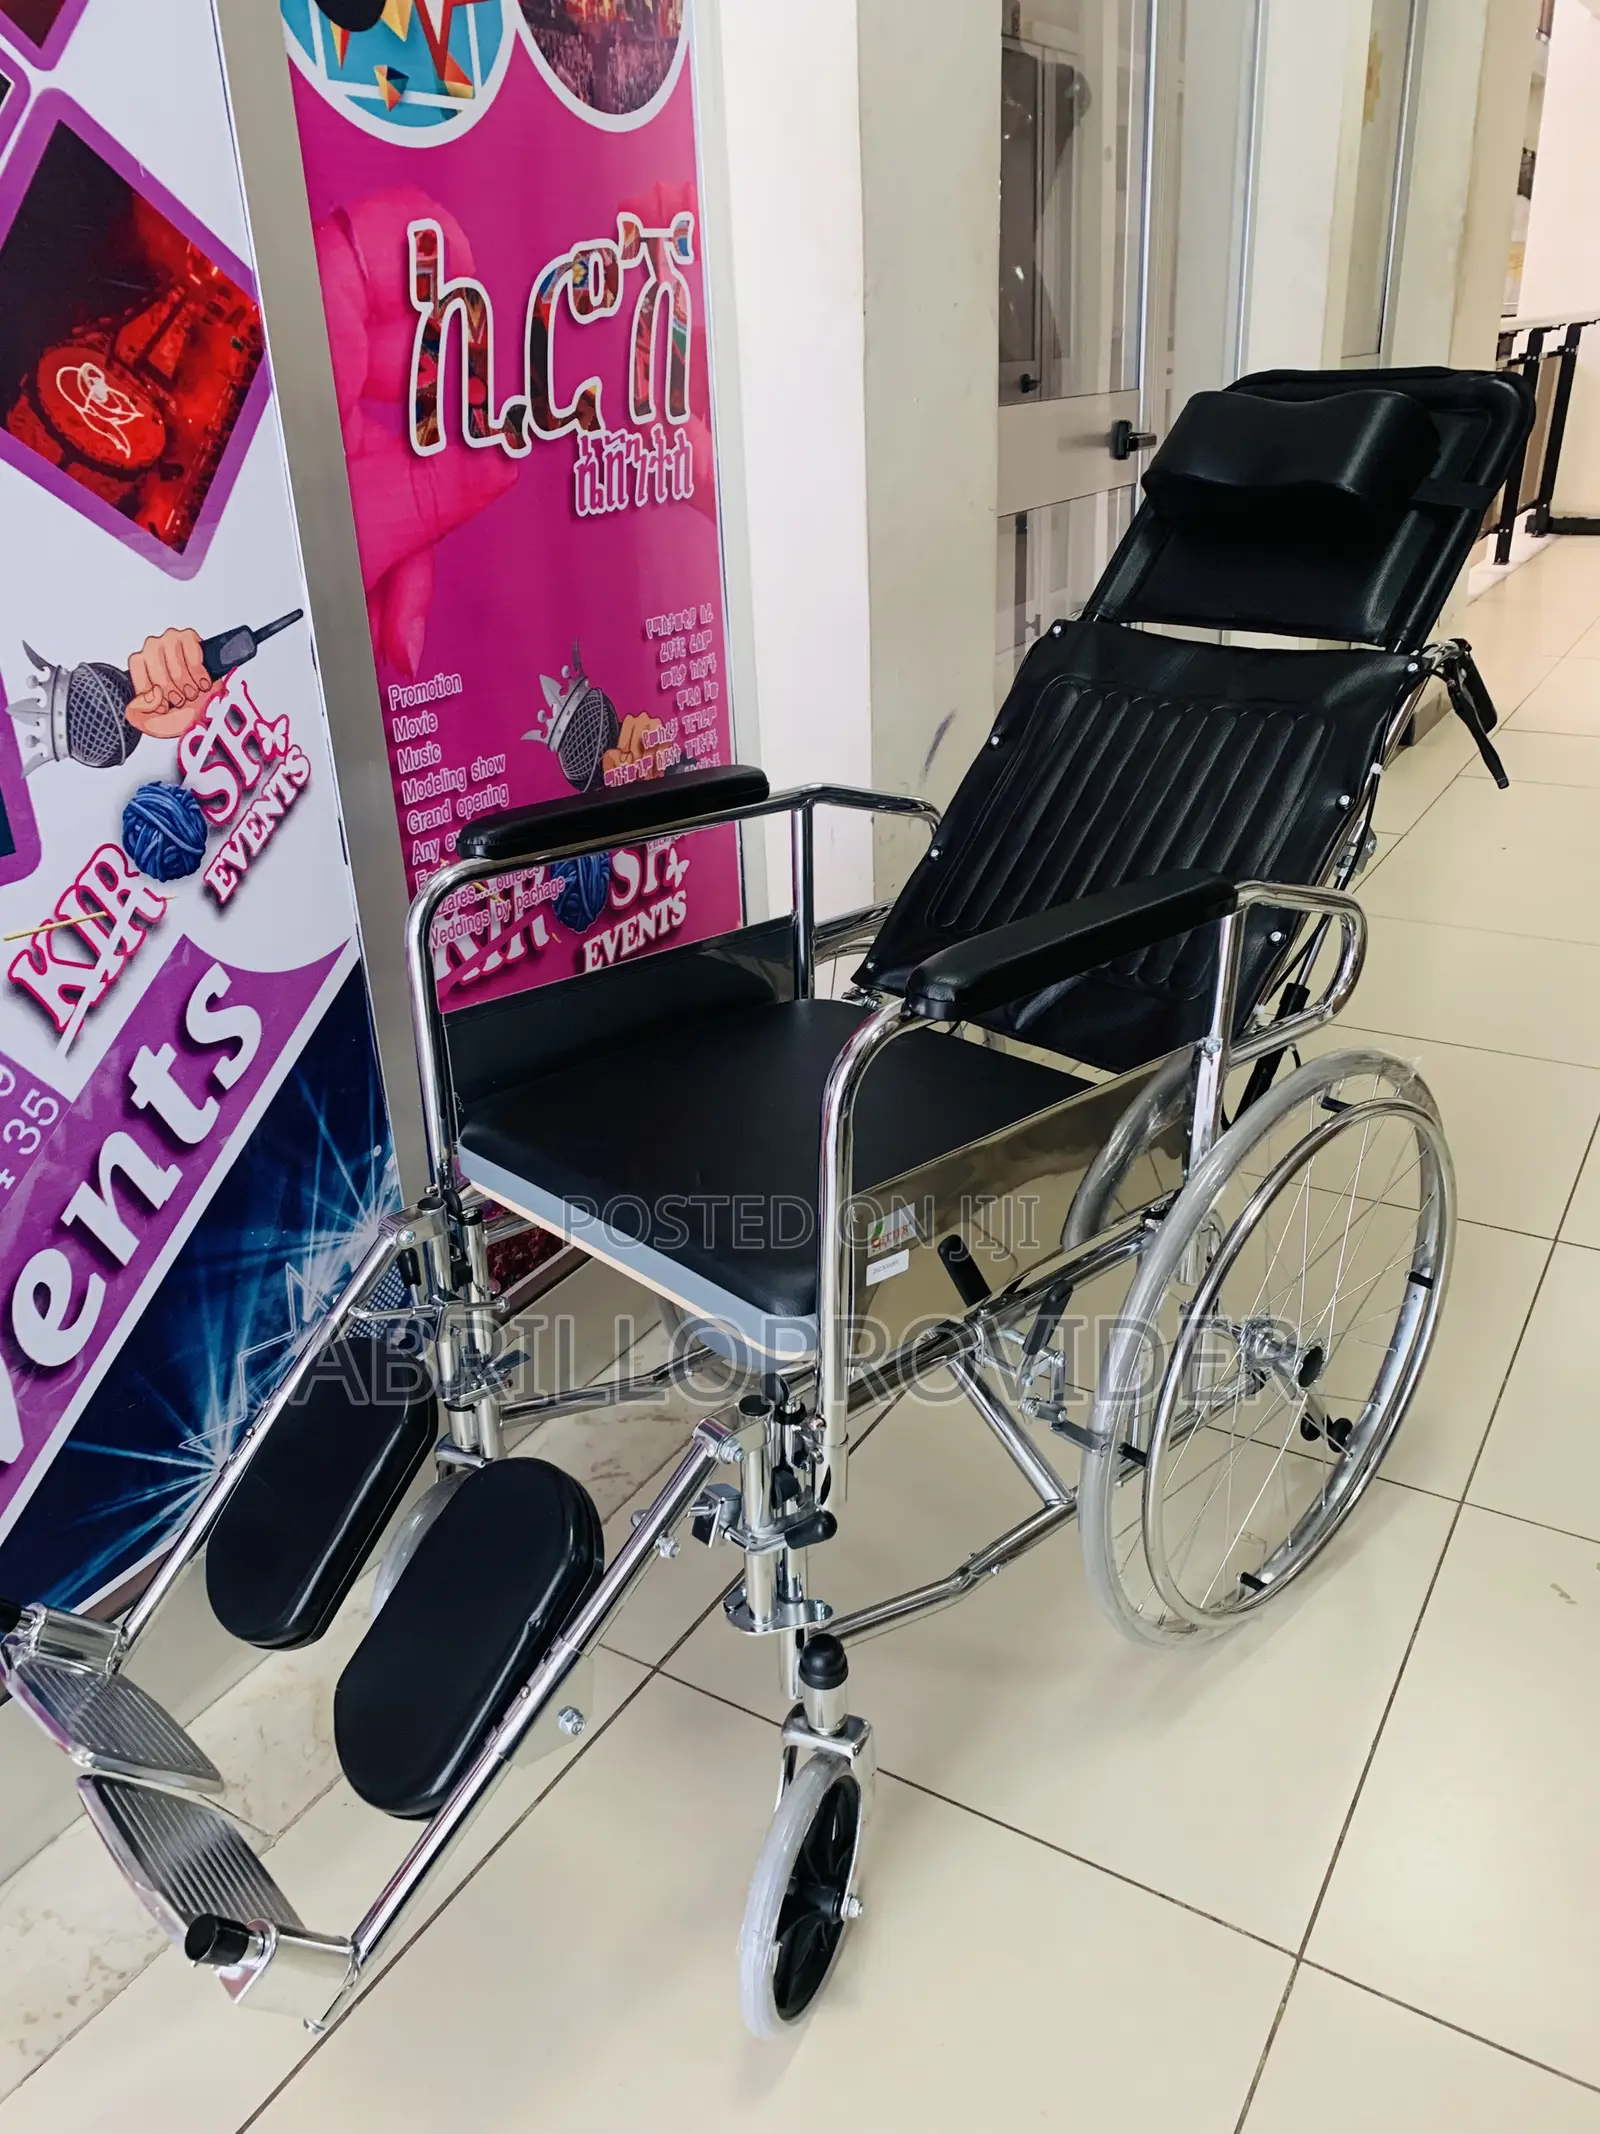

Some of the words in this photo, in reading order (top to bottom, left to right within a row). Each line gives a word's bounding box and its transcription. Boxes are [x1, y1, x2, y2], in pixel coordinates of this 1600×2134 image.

[388, 673, 463, 711] Promotion
[393, 710, 438, 743] Movie
[398, 741, 442, 774] Music
[402, 767, 467, 805] Modeling
[471, 754, 506, 782] show
[203, 745, 310, 905] EVENTS
[407, 799, 452, 835] Grand
[457, 783, 509, 820] opening
[412, 838, 440, 866] Any
[495, 896, 512, 924] by
[582, 889, 689, 974] EVENTS
